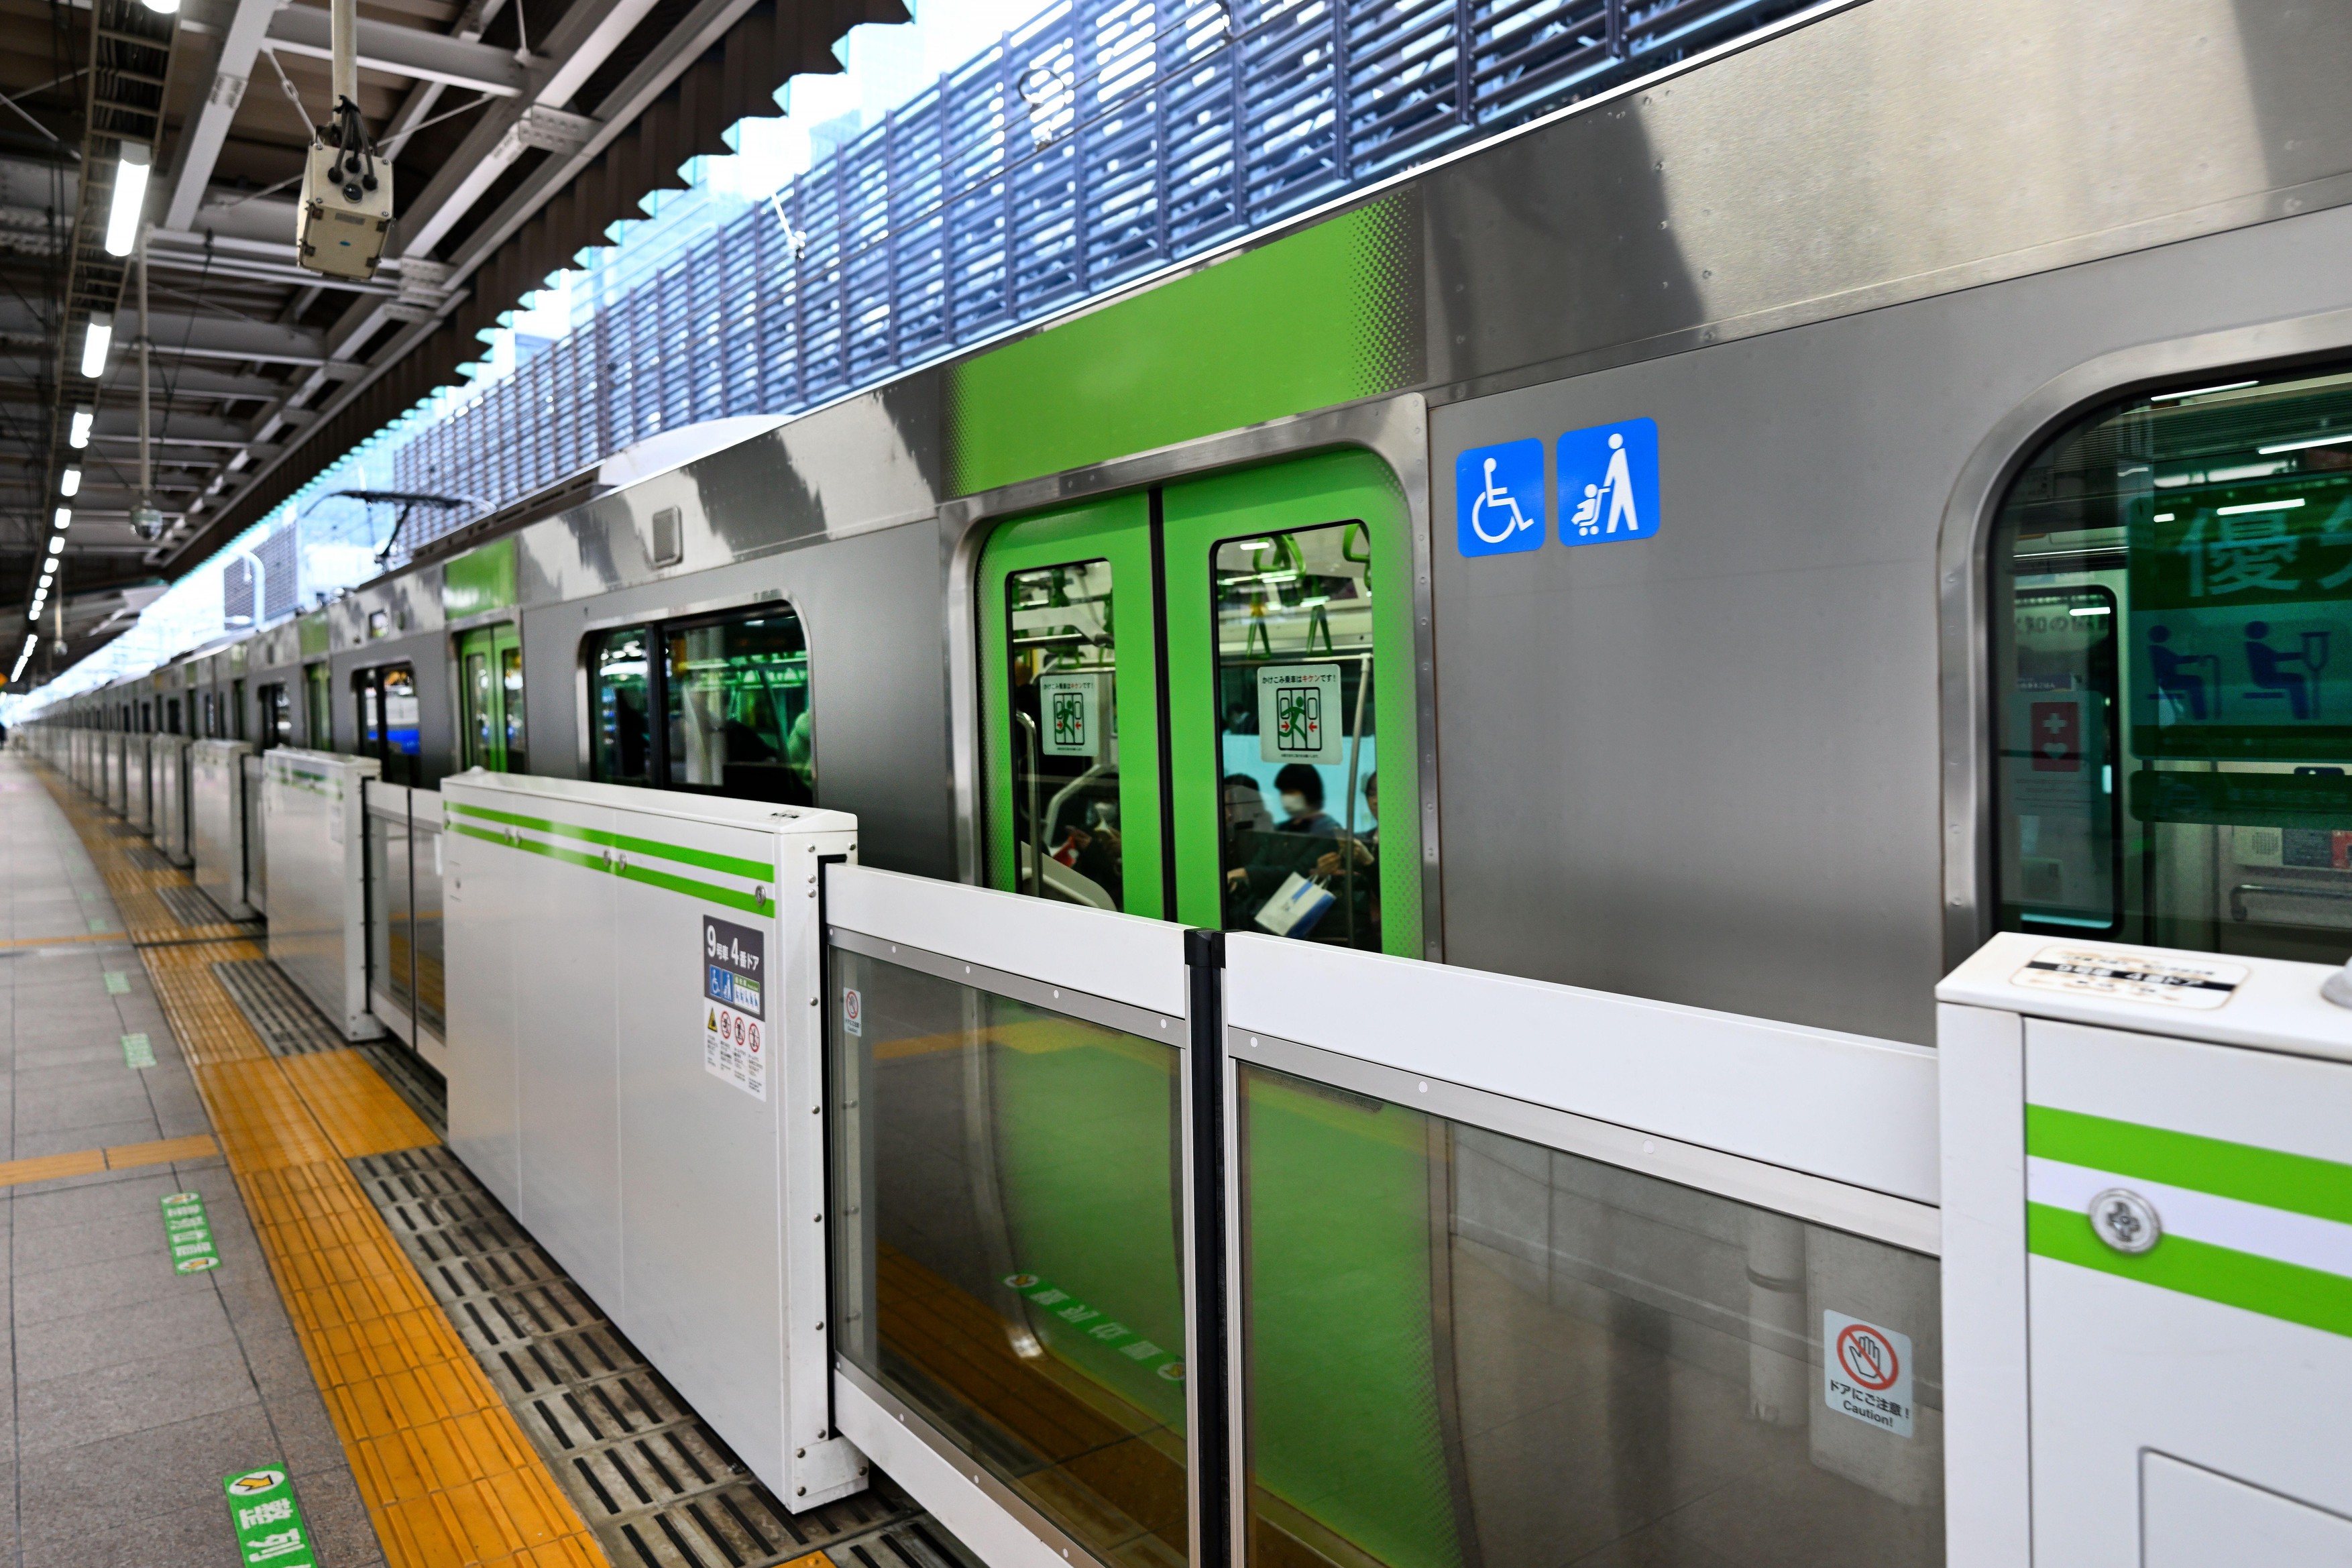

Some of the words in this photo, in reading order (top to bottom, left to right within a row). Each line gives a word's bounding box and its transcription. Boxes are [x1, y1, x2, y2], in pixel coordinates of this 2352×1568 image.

[707, 925, 729, 961] 9号車
[730, 938, 759, 971] 4番ドア
[1830, 1379, 1909, 1419] ドアにご注意！
[1843, 1400, 1893, 1428] Caution!
[238, 1498, 312, 1568] 整列
